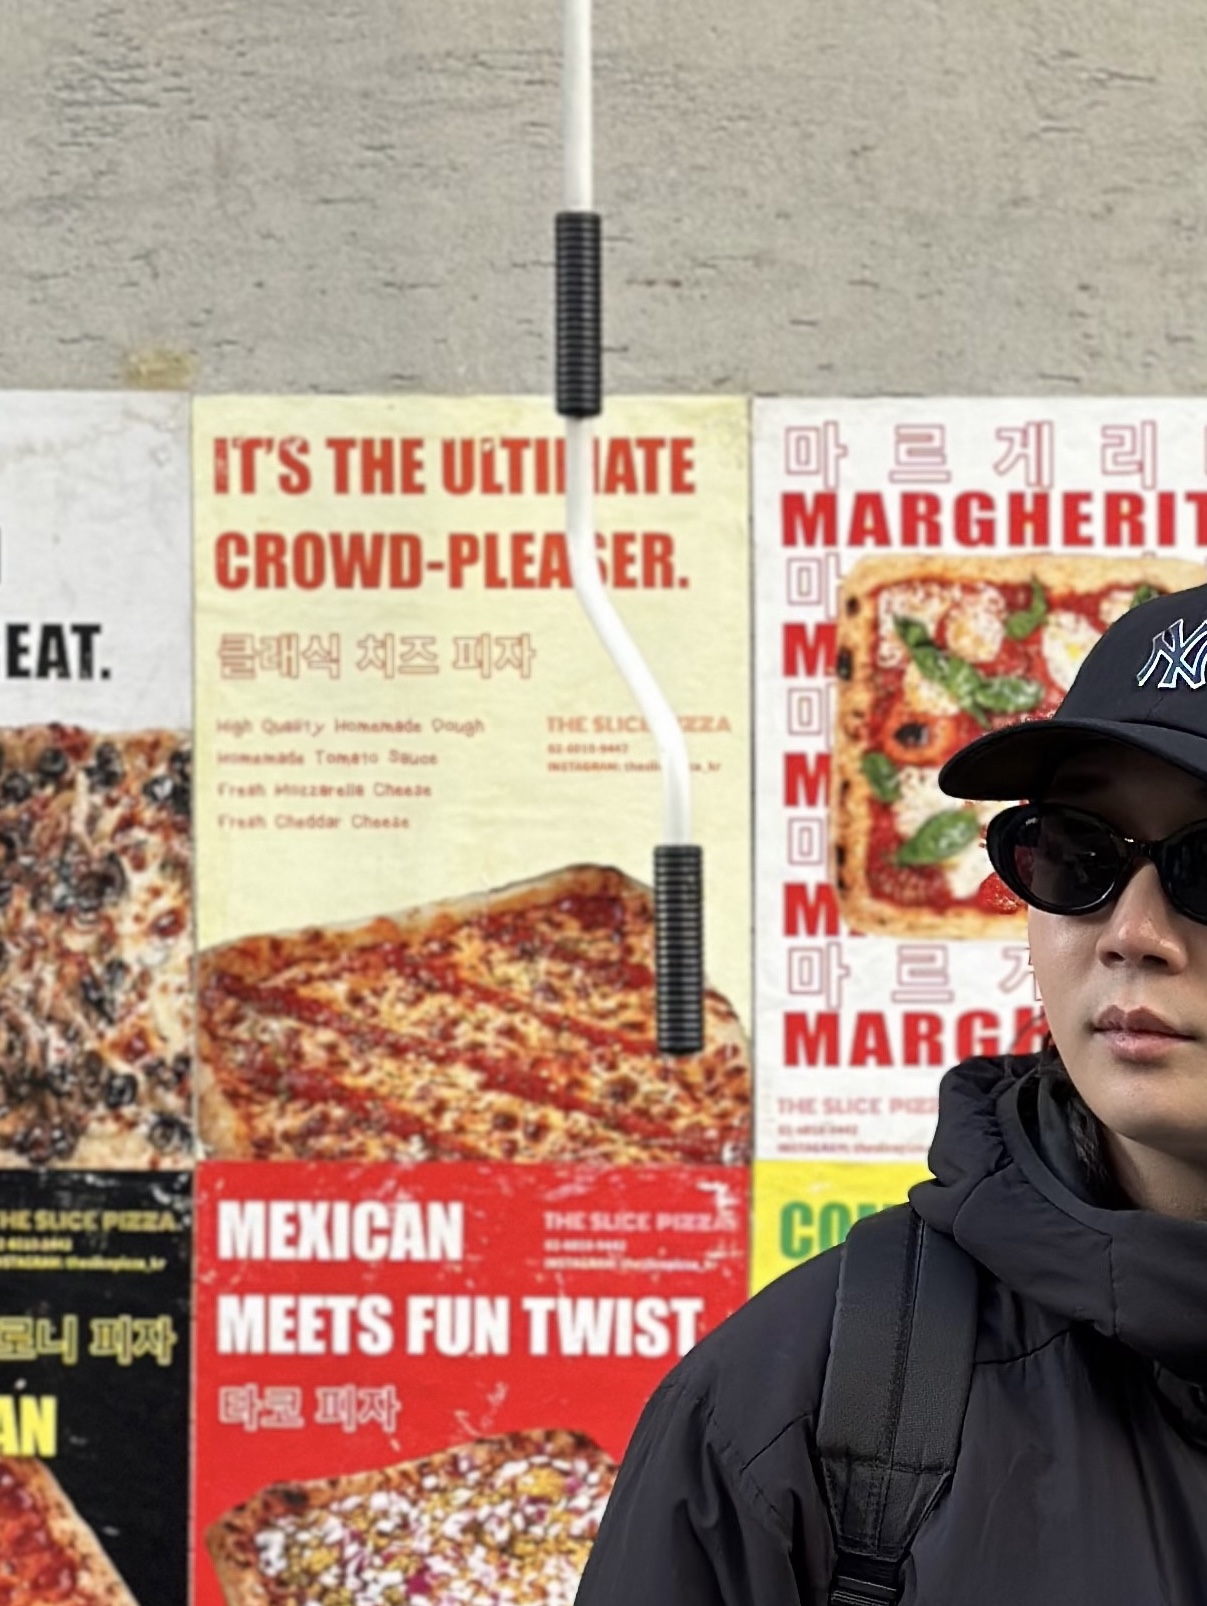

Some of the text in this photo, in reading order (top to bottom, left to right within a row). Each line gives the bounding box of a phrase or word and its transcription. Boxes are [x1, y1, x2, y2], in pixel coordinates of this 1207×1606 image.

[213, 437, 311, 495] IT'S
[326, 437, 425, 495] THE
[6, 624, 110, 680] EAT.
[218, 632, 537, 680] 클래식 치즈 피자
[216, 717, 485, 738] High Quality Homemade Dough
[547, 716, 588, 733] THE
[217, 748, 438, 765] Homemade Tomato Sauce
[374, 781, 432, 797] Cheese
[274, 814, 341, 829] Cheddar
[352, 814, 409, 829] Cheese
[217, 1200, 464, 1262] MEXICAN
[544, 1211, 586, 1231] THE
[589, 1211, 650, 1231] SLICE
[89, 1314, 178, 1367] 피자
[217, 1293, 704, 1357] MEETS FUN TWIST
[219, 1383, 399, 1432] 타코 피자
